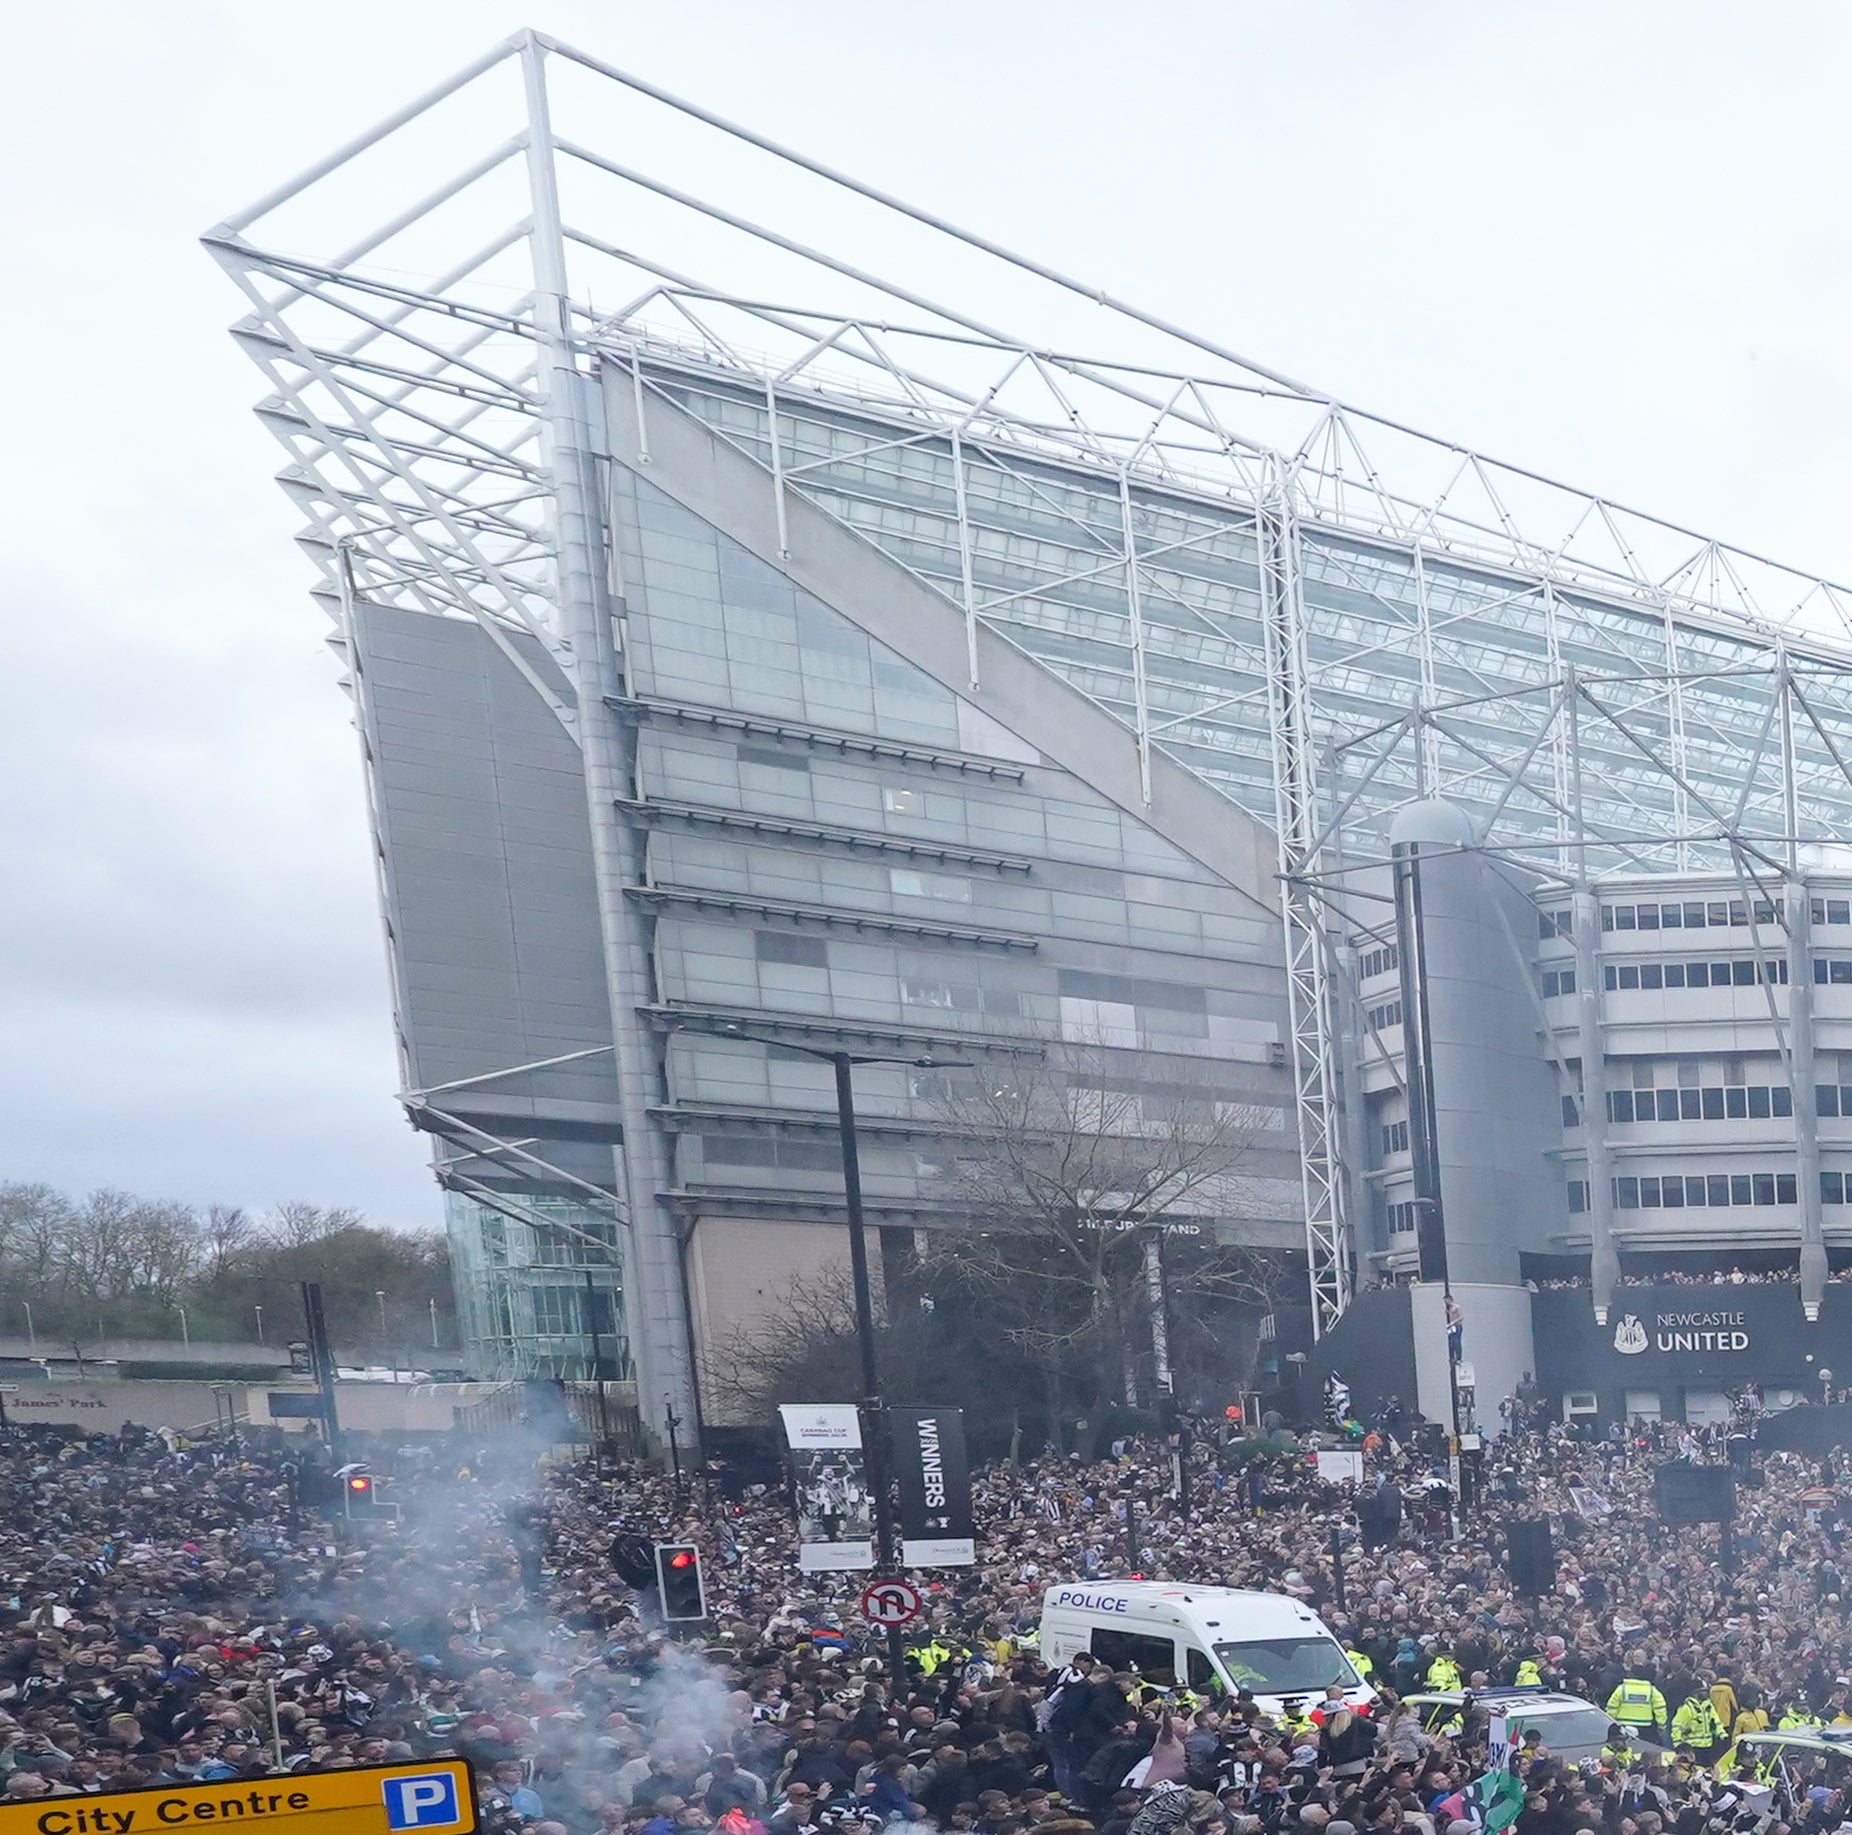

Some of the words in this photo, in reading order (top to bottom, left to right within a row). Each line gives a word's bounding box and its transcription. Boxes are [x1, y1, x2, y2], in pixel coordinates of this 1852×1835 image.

[1657, 1312, 1745, 1327] NEWCASTLE
[1656, 1331, 1749, 1351] UNITED
[70, 1399, 108, 1408] Park
[1059, 1592, 1128, 1612] POLICE
[156, 1787, 310, 1825] Centre
[400, 1780, 446, 1824] P
